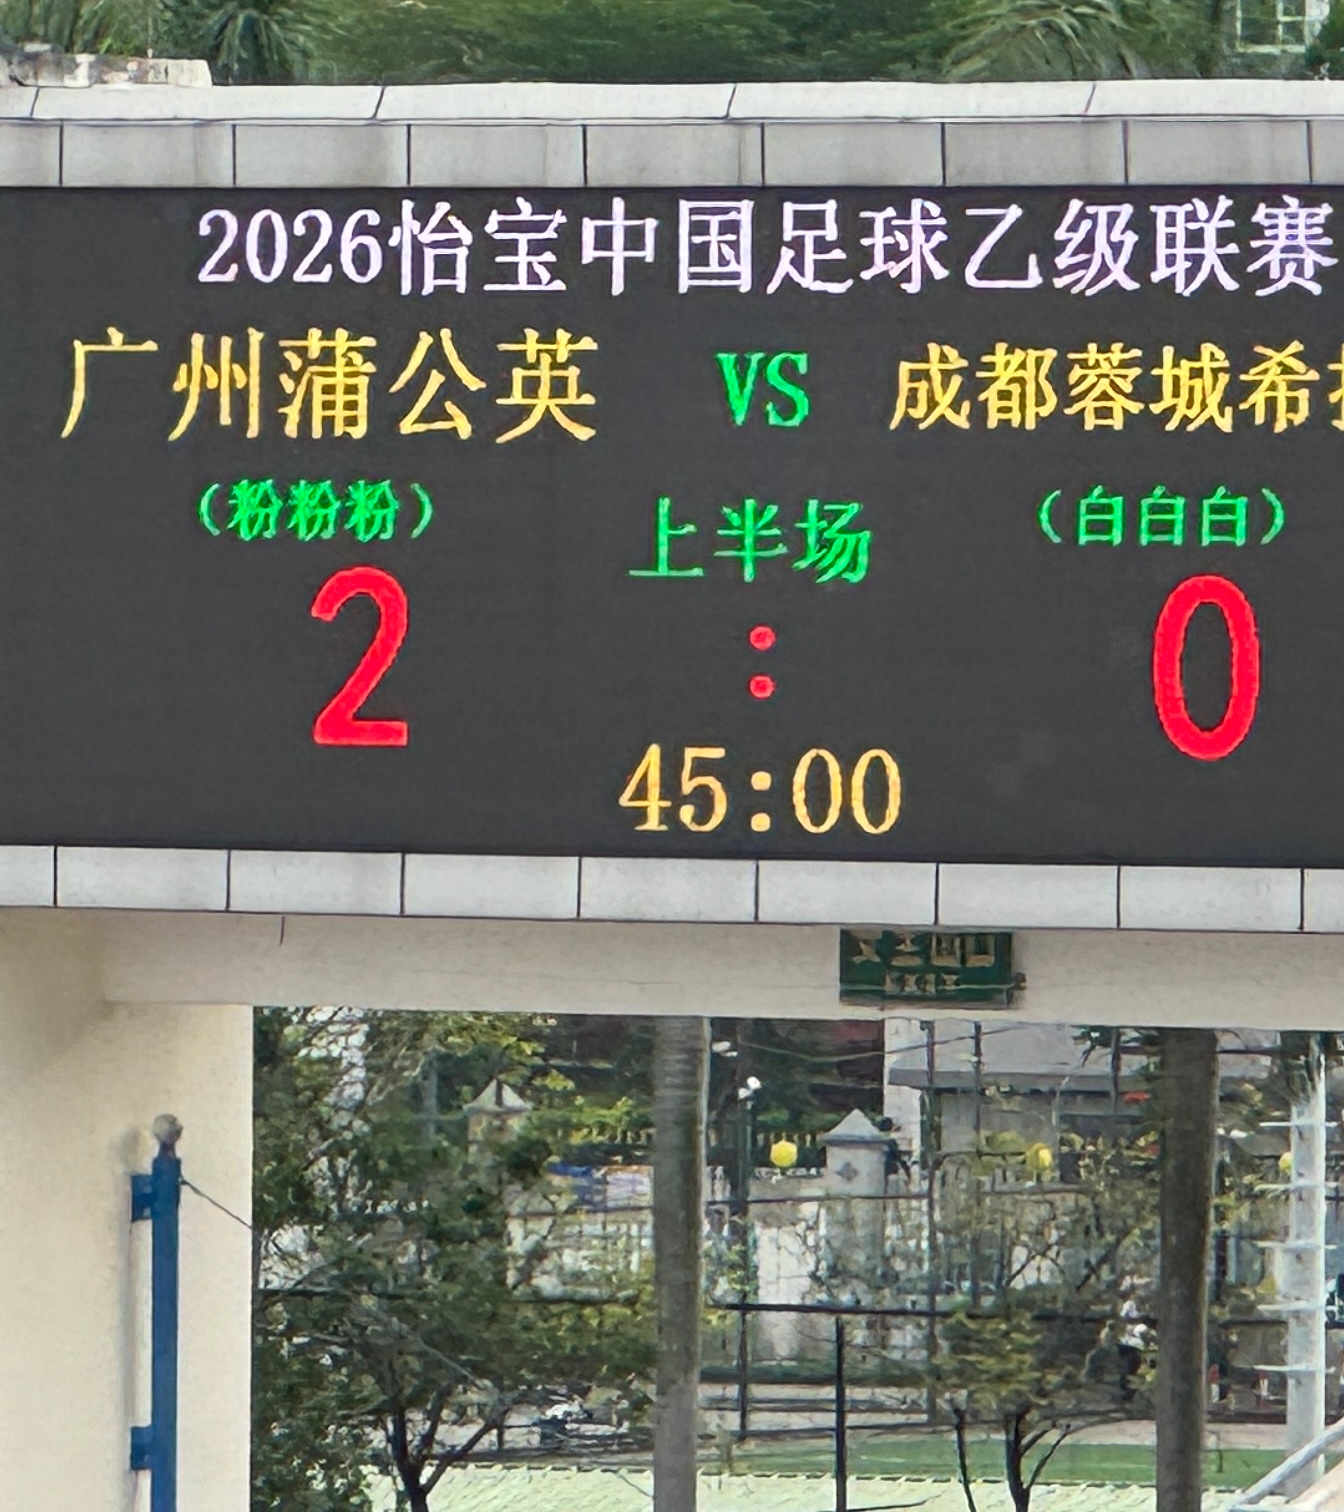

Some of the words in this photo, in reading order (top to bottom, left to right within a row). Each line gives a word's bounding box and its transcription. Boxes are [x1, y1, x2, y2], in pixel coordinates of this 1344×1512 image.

[196, 196, 1340, 298] 2026怡宝中国足球乙级联赛
[61, 327, 599, 443] 广州蒲公英
[715, 351, 810, 428] VS
[197, 478, 434, 544] （粉粉粉）
[628, 496, 874, 584] 上半场
[1037, 484, 1285, 548] （白白白）
[309, 565, 409, 748] 2
[1152, 573, 1261, 762] 0
[618, 742, 902, 835] 45:00
